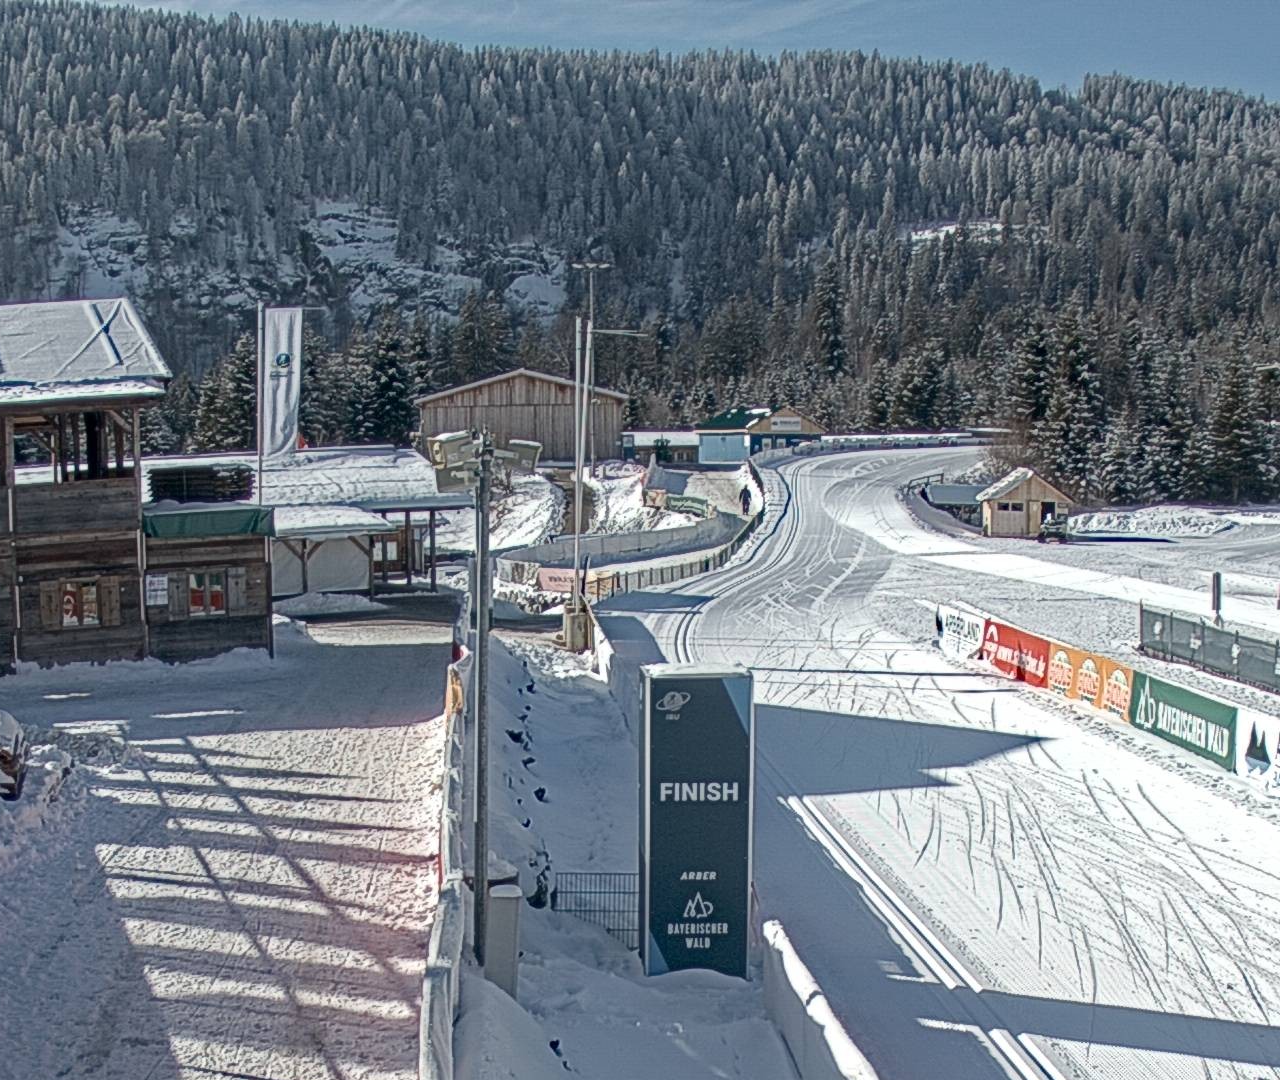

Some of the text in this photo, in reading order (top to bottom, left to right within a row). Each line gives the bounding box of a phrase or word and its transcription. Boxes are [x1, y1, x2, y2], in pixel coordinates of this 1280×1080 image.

[659, 782, 739, 802] FINISH
[680, 871, 717, 881] ARBER
[667, 922, 729, 935] BAYERISCHER
[685, 937, 711, 949] WALD
